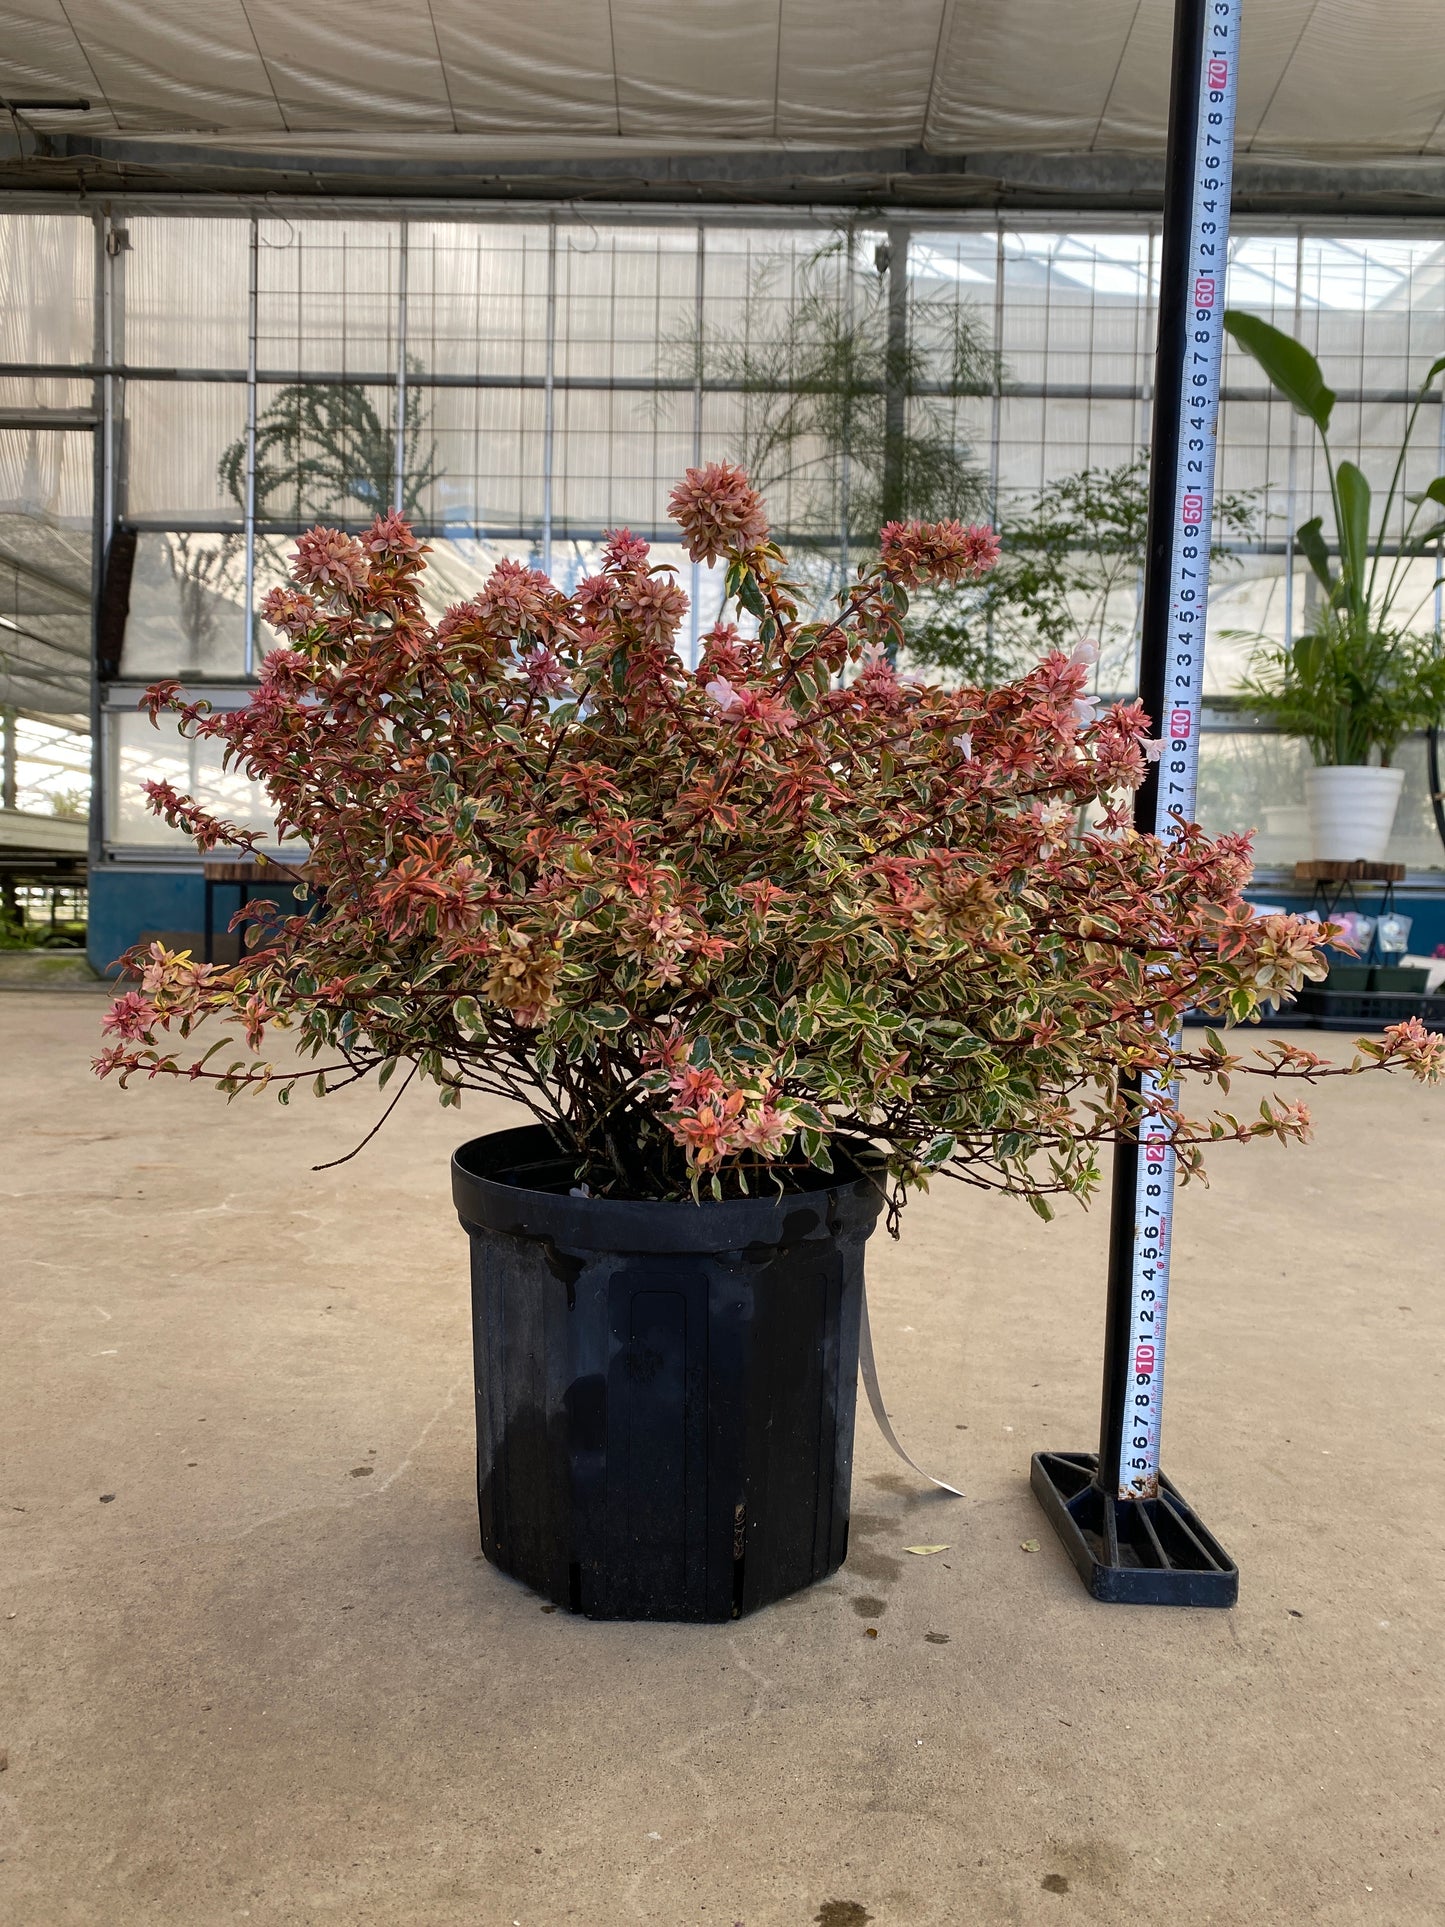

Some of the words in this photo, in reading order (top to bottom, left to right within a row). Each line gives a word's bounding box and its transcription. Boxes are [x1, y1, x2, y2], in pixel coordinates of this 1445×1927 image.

[1214, 2, 1230, 16] 3
[1213, 24, 1228, 37] 2
[1212, 49, 1227, 58] 1
[1209, 62, 1226, 85] 70
[1209, 90, 1224, 103] 9
[1208, 112, 1223, 125] 8
[1206, 134, 1222, 146] 7
[1205, 155, 1220, 169] 6
[1203, 177, 1219, 190] 5
[1203, 199, 1218, 213] 4
[1201, 221, 1217, 235] 3
[1200, 243, 1215, 256] 2
[1199, 268, 1214, 277] 1
[1196, 281, 1214, 305] 60
[1196, 309, 1211, 322] 9
[1194, 330, 1210, 344] 8
[1193, 351, 1209, 365] 7
[1192, 373, 1208, 387] 6
[1190, 395, 1207, 408] 5
[1190, 416, 1205, 430] 4
[1188, 438, 1204, 451] 3
[1187, 460, 1203, 473] 2
[1186, 485, 1201, 493] 1
[1184, 499, 1201, 520] 50
[1184, 525, 1199, 537] 9
[1182, 546, 1198, 559] 8
[1181, 567, 1197, 580] 7
[1180, 589, 1196, 602] 6
[1179, 611, 1195, 624] 5
[1178, 632, 1193, 645] 4
[1176, 653, 1192, 667] 3
[1175, 675, 1191, 688] 2
[1174, 699, 1190, 708] 1
[1172, 712, 1190, 735] 40
[1171, 739, 1187, 752] 9
[1170, 760, 1186, 774] 8
[1169, 782, 1185, 795] 7
[1168, 803, 1183, 815] 6
[1150, 1124, 1164, 1132] 1
[1147, 1163, 1163, 1176] 9
[1146, 1184, 1161, 1197] 8
[1145, 1205, 1160, 1217] 7
[1144, 1226, 1159, 1239] 6
[1143, 1247, 1158, 1260] 5
[1142, 1268, 1157, 1281] 4
[1140, 1289, 1156, 1302] 3
[1140, 1310, 1154, 1323] 2
[1139, 1334, 1153, 1343] 1
[1137, 1348, 1154, 1369] 10
[1136, 1373, 1151, 1386] 9
[1135, 1394, 1150, 1407] 8
[1134, 1415, 1149, 1428] 7
[1132, 1436, 1148, 1449] 6
[1131, 1457, 1147, 1470] 5
[1131, 1478, 1146, 1492] 4
